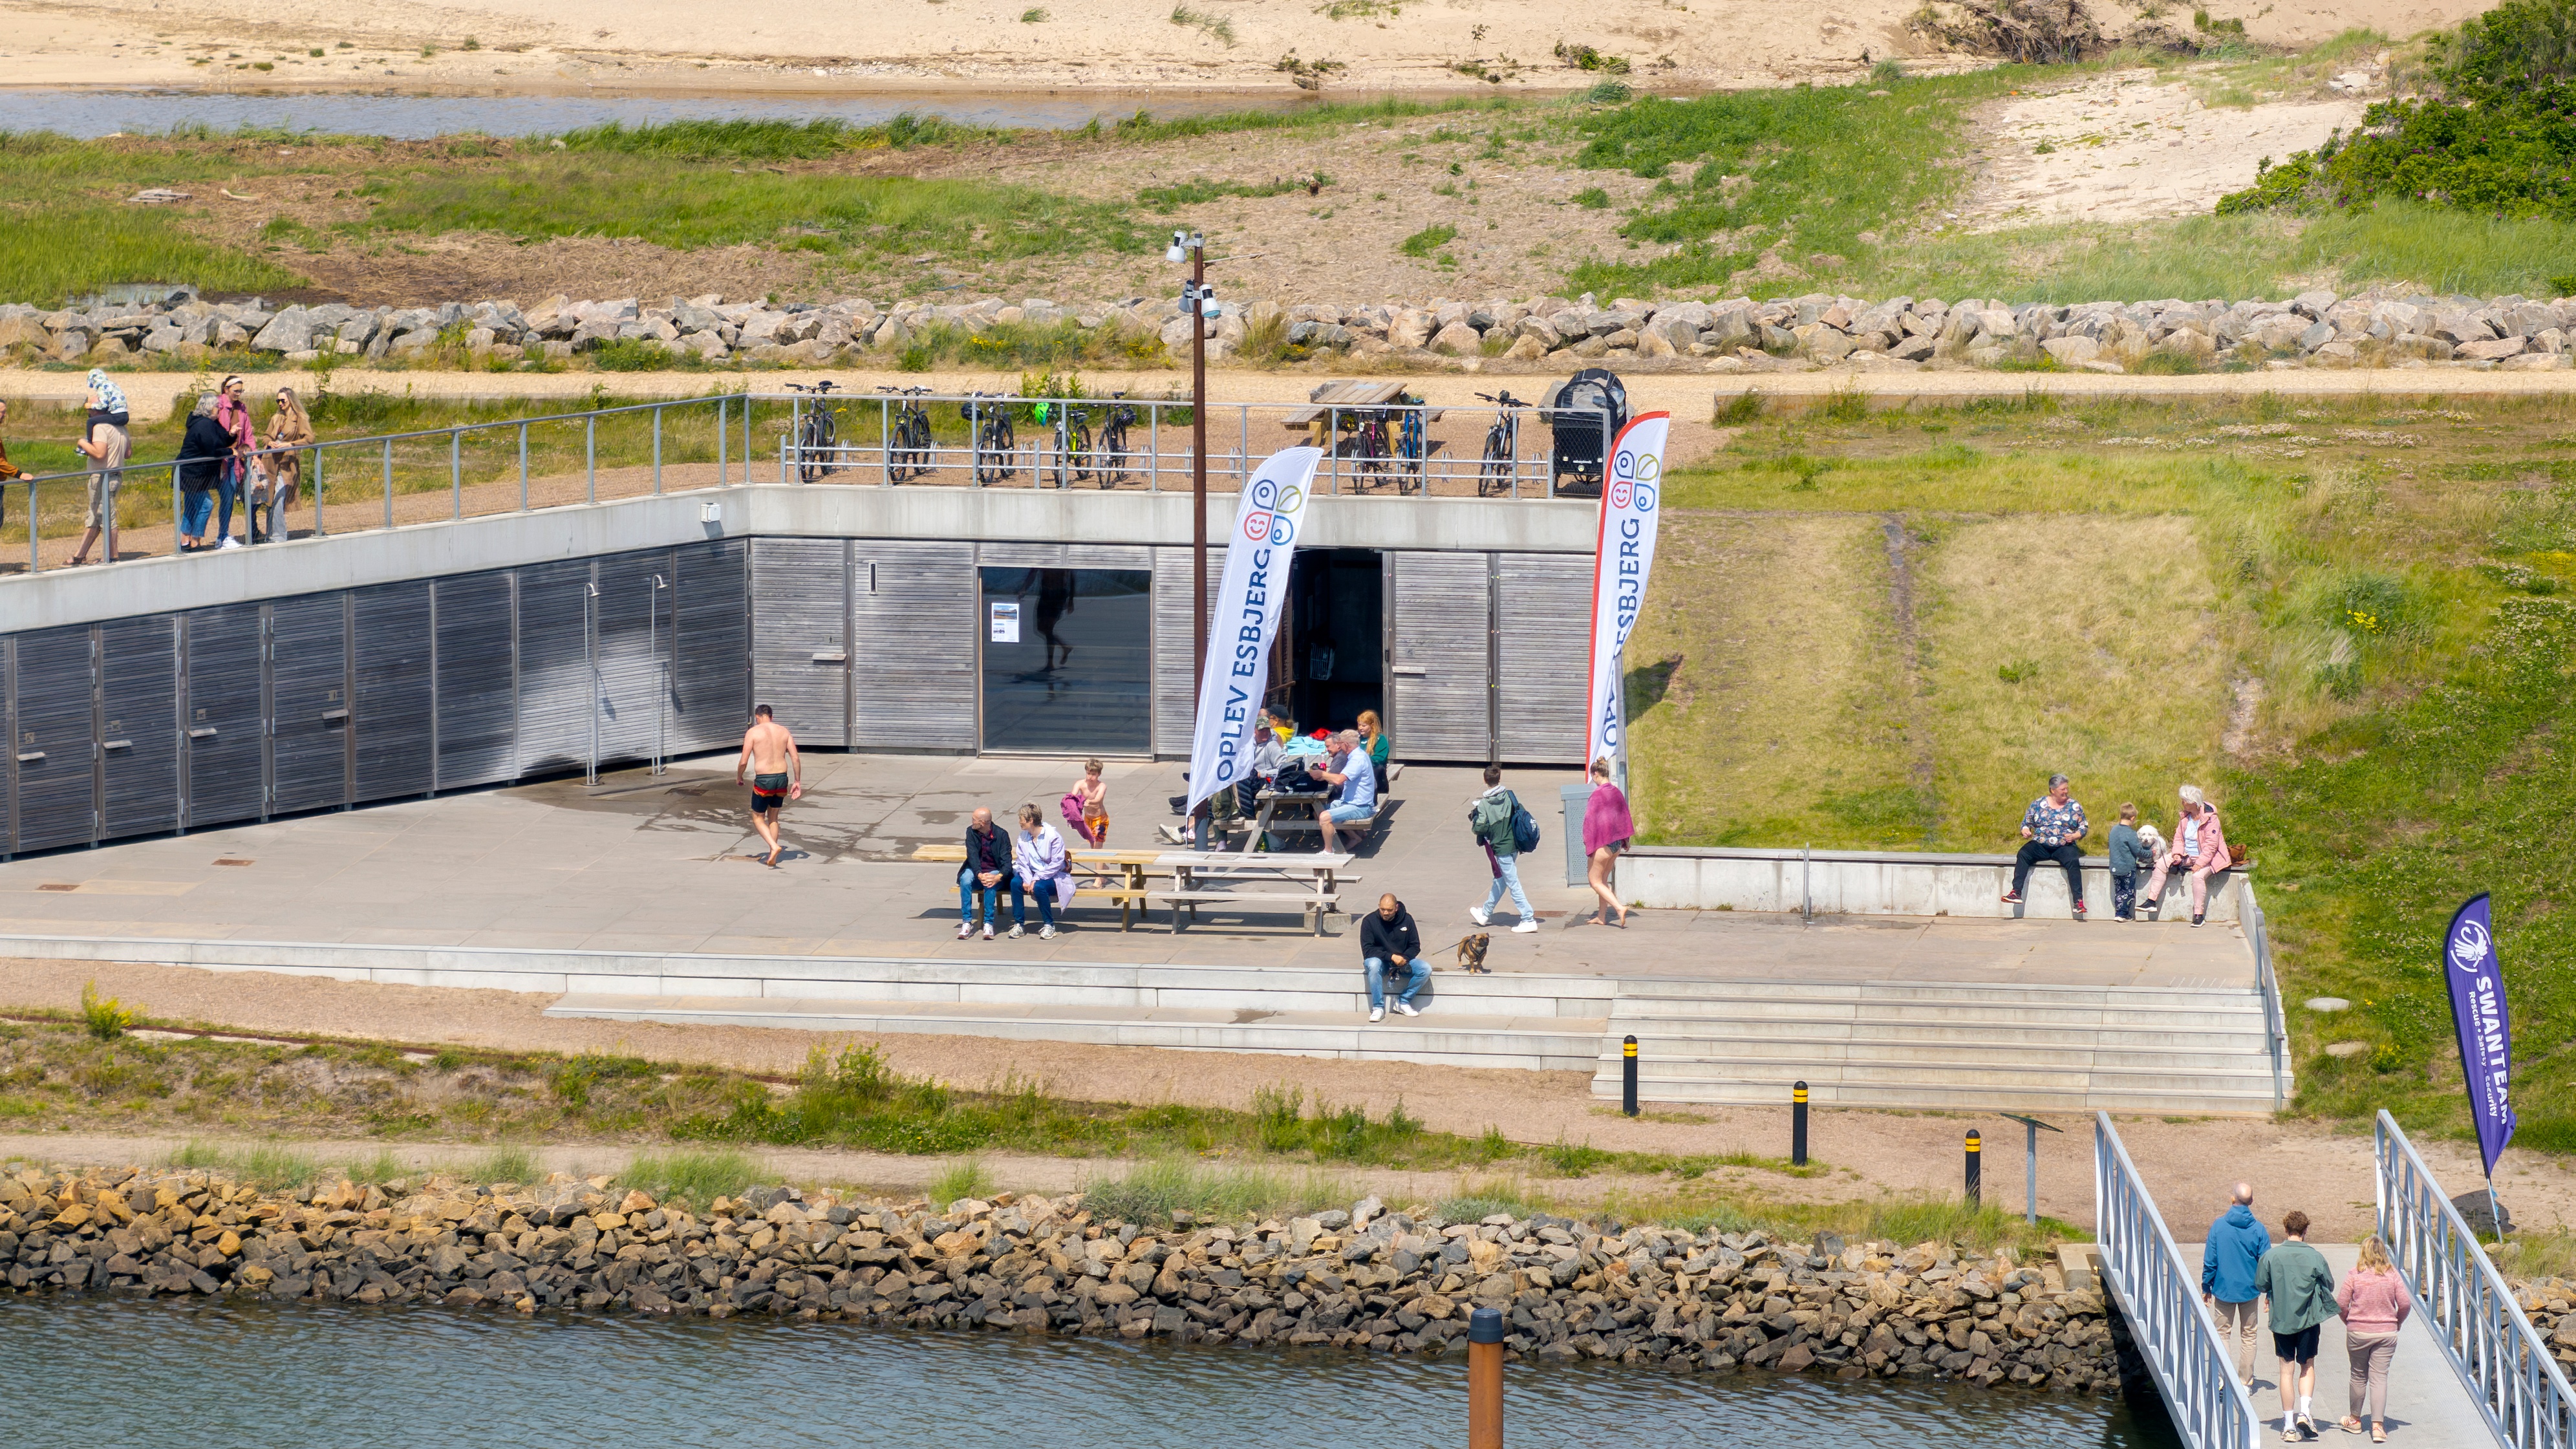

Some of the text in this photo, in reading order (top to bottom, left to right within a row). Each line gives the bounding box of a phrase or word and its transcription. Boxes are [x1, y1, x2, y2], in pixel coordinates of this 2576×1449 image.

[1217, 548, 1271, 782] OPLEV ESBJERG
[2469, 991, 2498, 1117] Rescue Safety Security
[2476, 976, 2508, 1125] SWANTEAM
